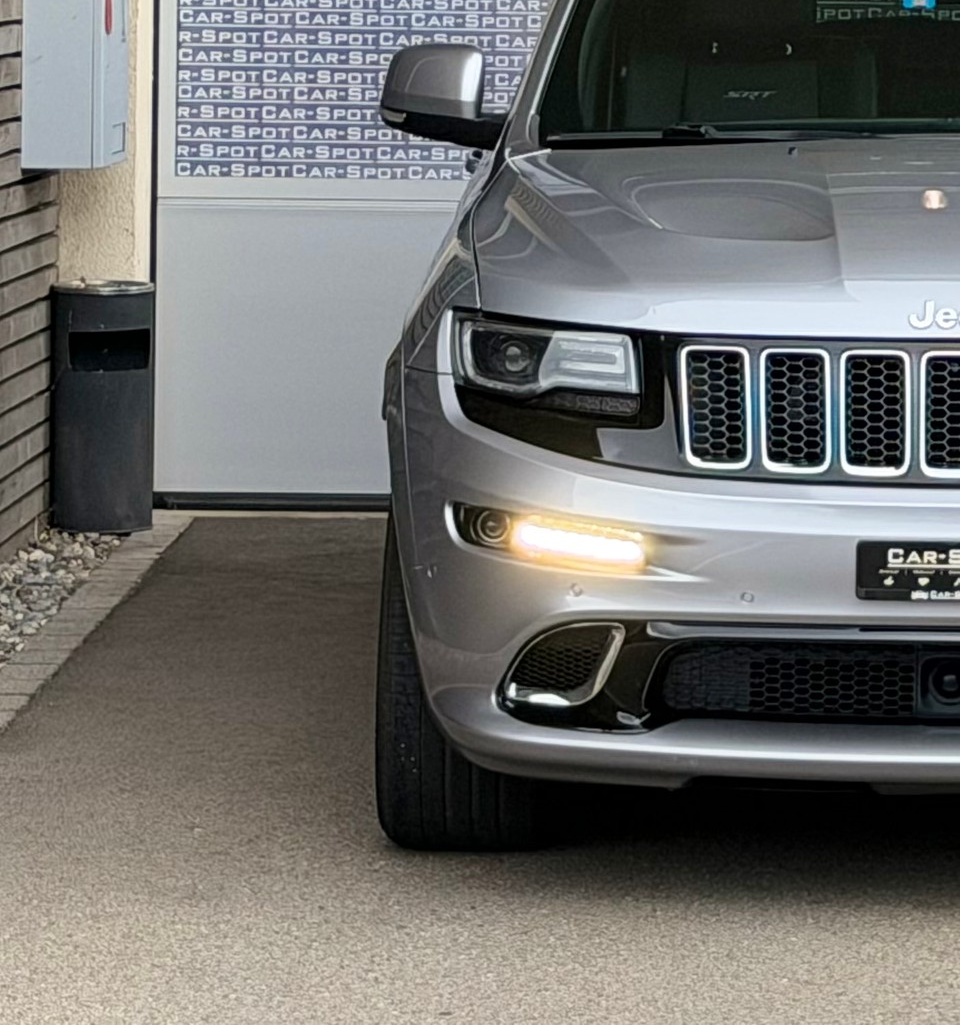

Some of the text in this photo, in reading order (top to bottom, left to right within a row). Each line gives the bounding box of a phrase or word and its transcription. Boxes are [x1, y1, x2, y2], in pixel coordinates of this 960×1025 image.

[180, 9, 524, 28] CAR-SPOT CAR-SPOT CAR-SPOT
[180, 29, 261, 43] R-SPOT
[263, 30, 377, 45] CAR-SPOT
[180, 48, 292, 63] CAR-SPOT
[179, 68, 376, 84] R-SPOT CAR-SPOT
[179, 85, 291, 99] CAR-SPOT
[179, 104, 376, 120] R-SPOT CAR-SPOT
[178, 124, 291, 138] CAR-SPOT
[178, 143, 375, 159] R-SPOT CAR-SPOT
[178, 162, 406, 179] CAR-SPOT CAR-SPOT
